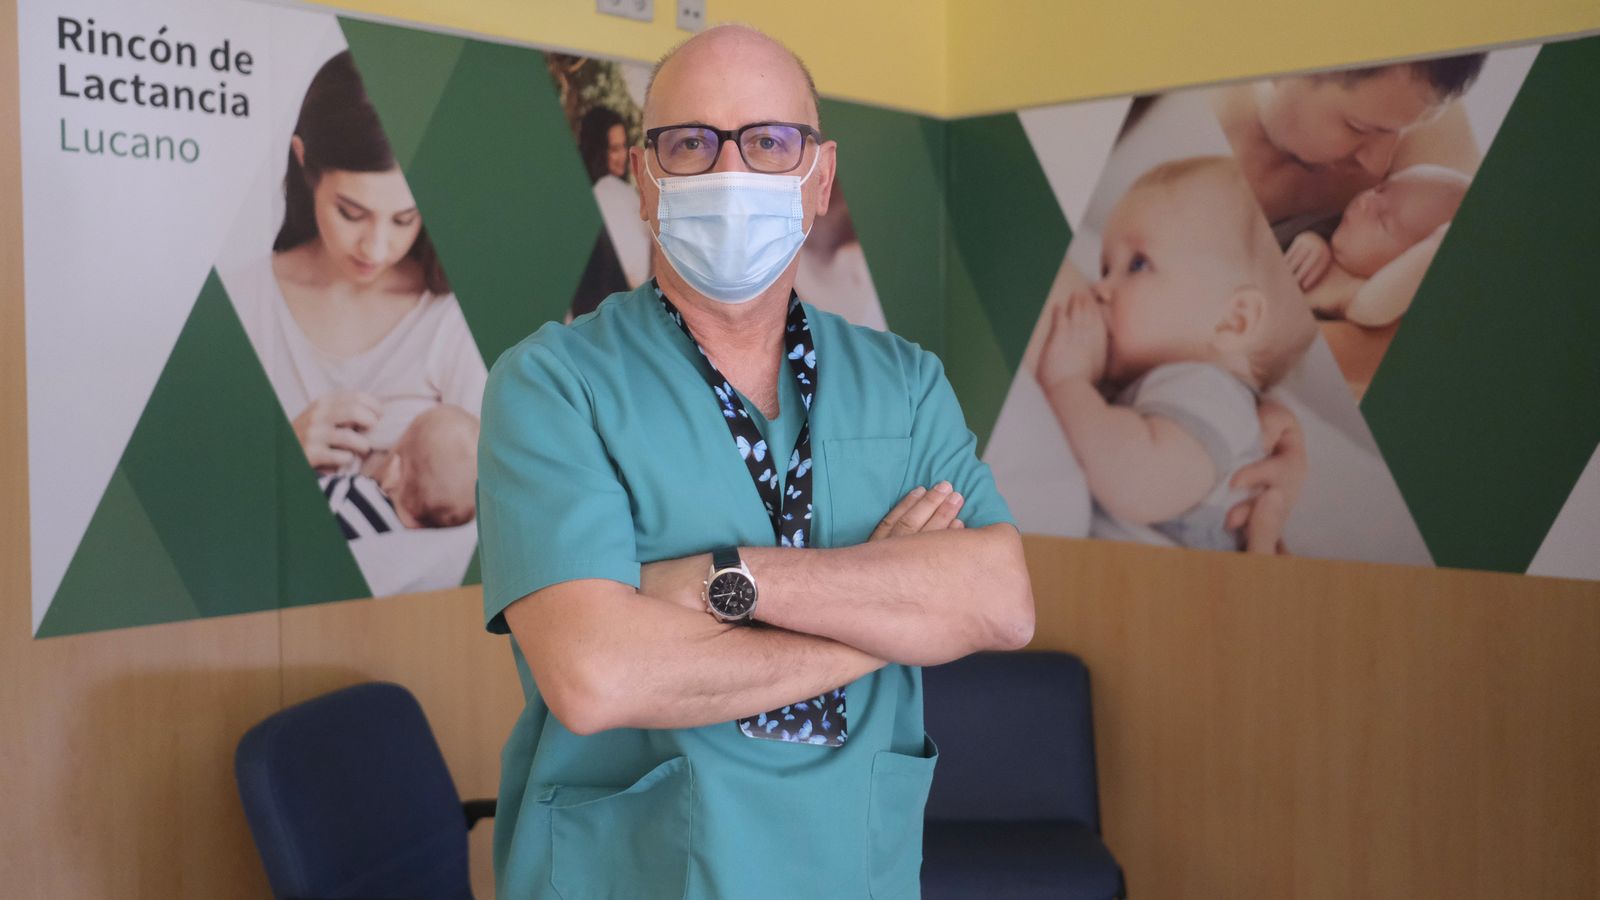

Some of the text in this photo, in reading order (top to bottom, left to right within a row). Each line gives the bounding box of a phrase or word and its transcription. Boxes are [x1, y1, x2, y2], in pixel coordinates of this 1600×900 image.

[58, 17, 253, 75] Rincón de
[58, 64, 249, 117] Lactancia
[60, 118, 200, 163] Lucano
